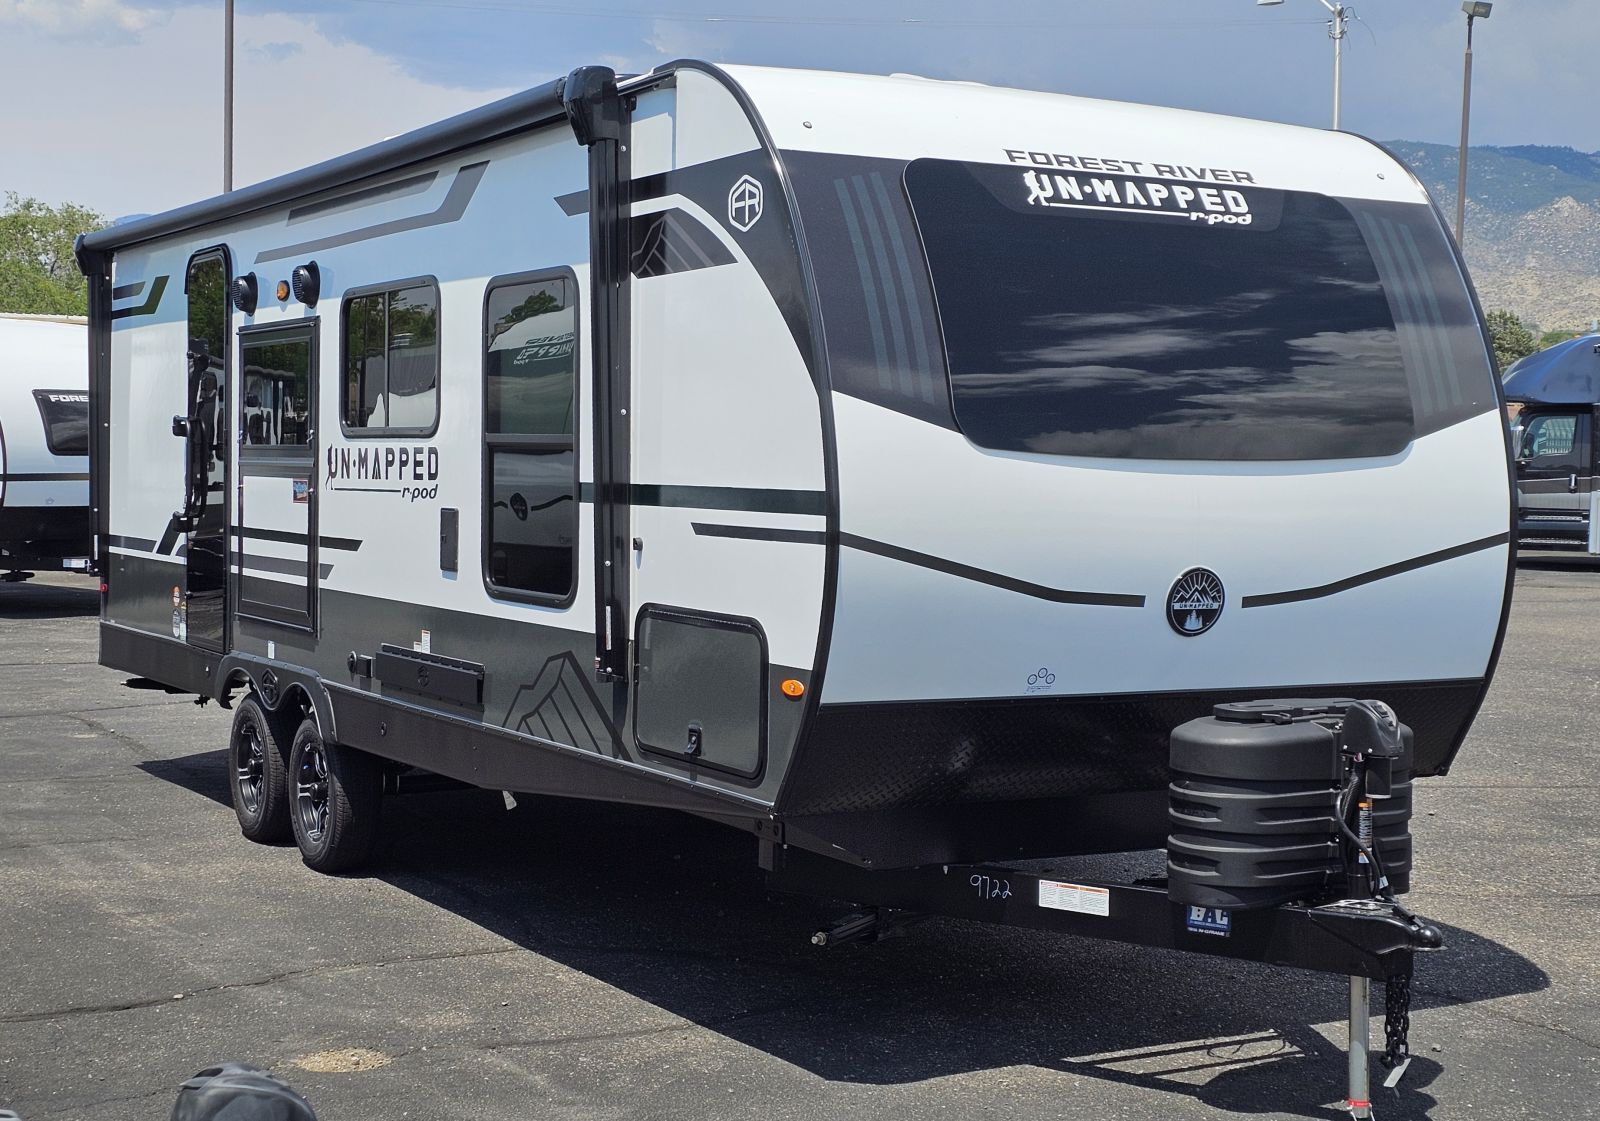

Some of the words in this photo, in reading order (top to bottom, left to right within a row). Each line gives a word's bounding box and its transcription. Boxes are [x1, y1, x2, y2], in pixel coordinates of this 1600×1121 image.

[1002, 149, 1142, 174] FOREST
[1150, 163, 1257, 184] RIVER
[48, 394, 89, 403] FORE
[969, 874, 1012, 900] 9722
